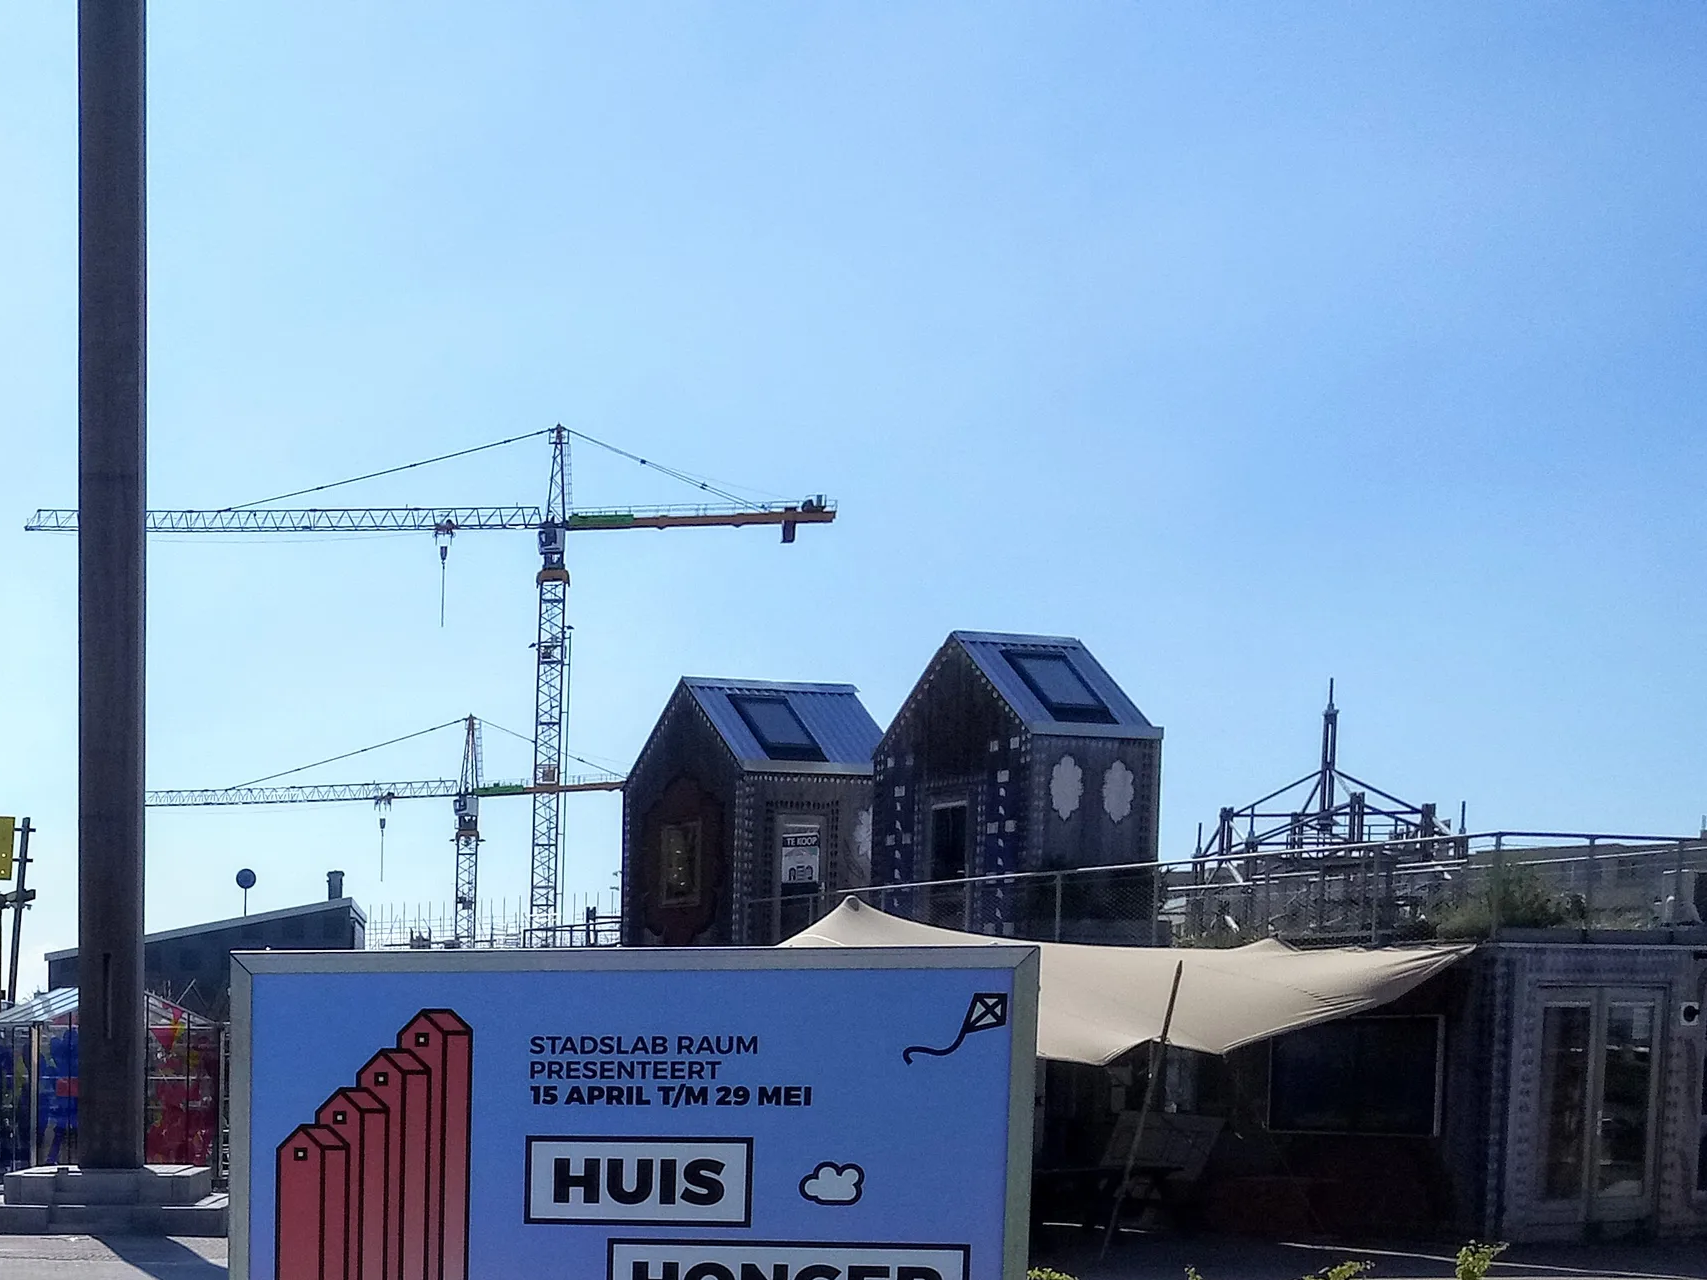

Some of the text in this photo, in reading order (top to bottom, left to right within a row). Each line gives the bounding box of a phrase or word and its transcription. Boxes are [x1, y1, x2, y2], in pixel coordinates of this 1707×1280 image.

[797, 837, 818, 846] KOOP
[530, 1036, 757, 1054] STADSLAB RAUM
[530, 1061, 721, 1079] PRESENTEERT
[531, 1084, 811, 1107] 15 APRIL T/M 29 MEI
[554, 1158, 725, 1205] HUIS
